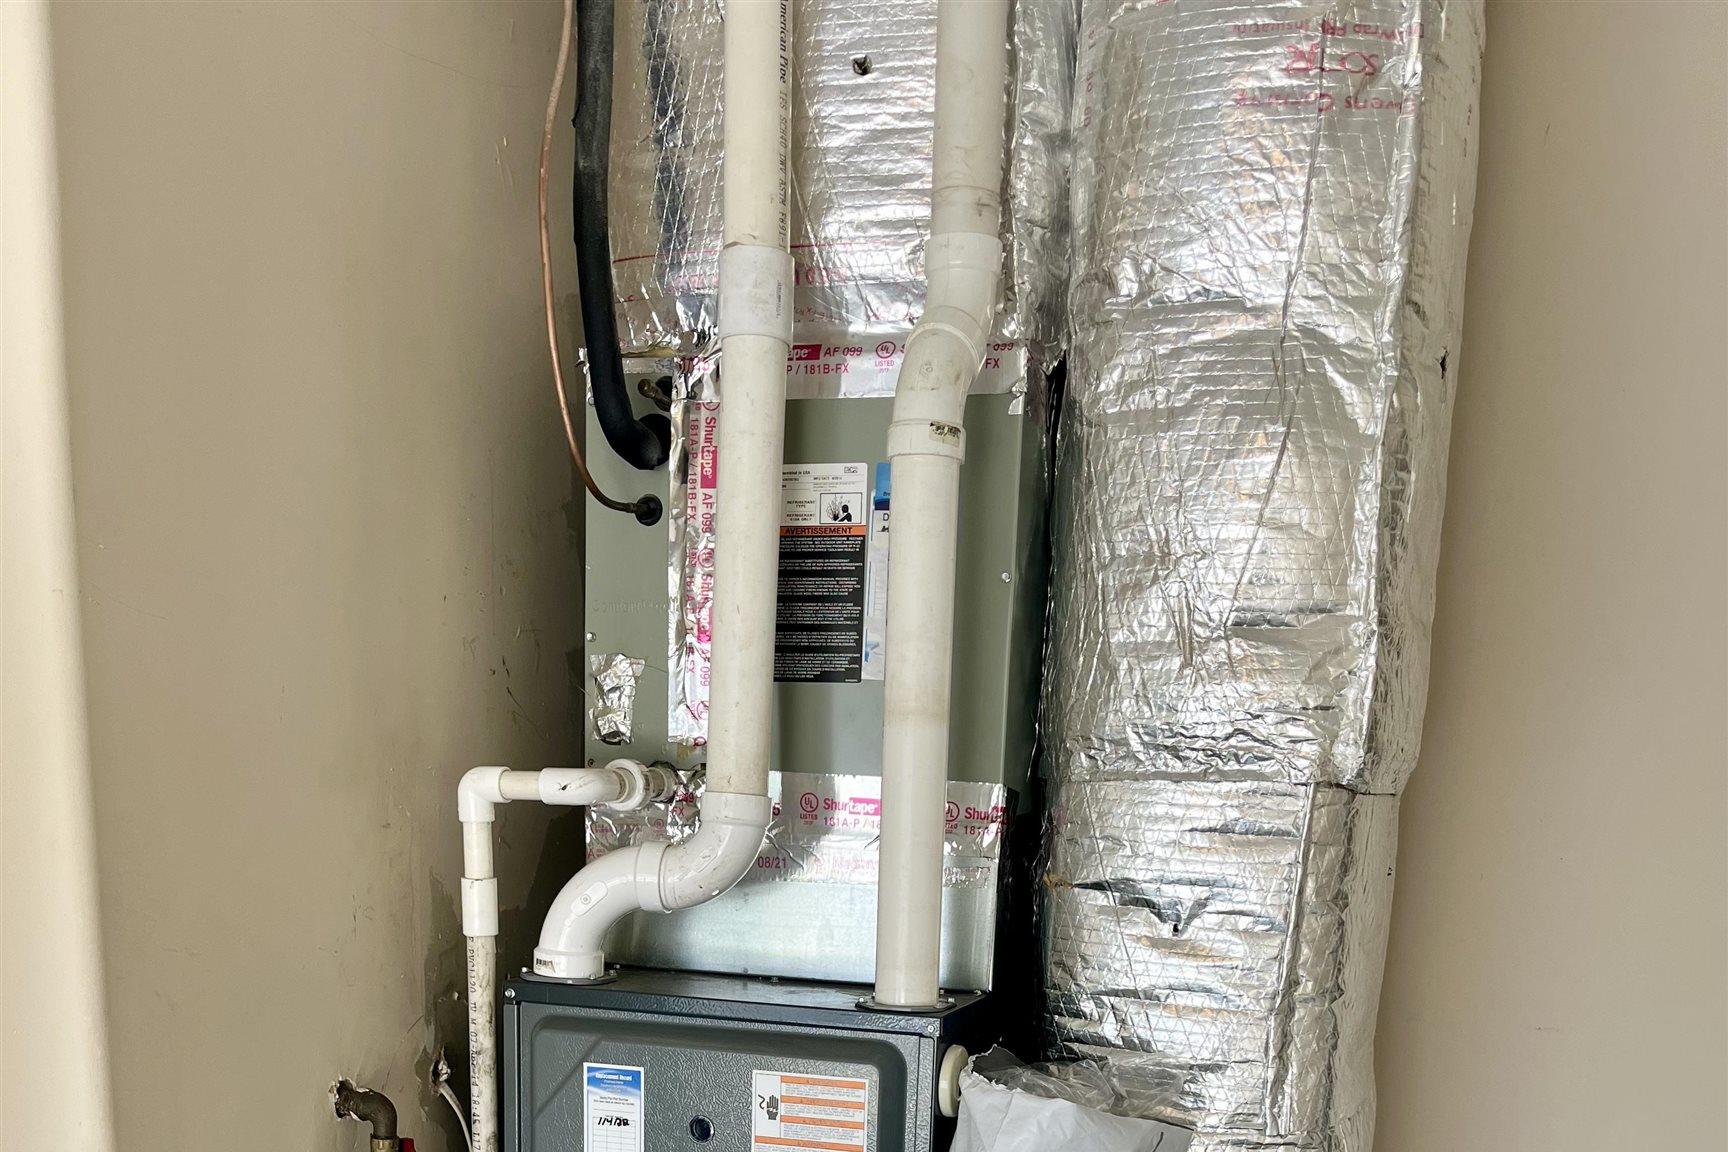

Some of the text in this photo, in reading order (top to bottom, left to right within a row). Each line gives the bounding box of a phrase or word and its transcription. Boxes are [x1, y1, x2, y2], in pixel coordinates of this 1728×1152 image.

[780, 0, 788, 52] merican
[842, 347, 863, 357] 099
[804, 363, 850, 375] 181B-FX
[701, 416, 718, 479] Shurtape
[785, 527, 853, 535] AVERTISSEMENT
[823, 798, 879, 814] Shurtape
[758, 856, 788, 869] 08/21
